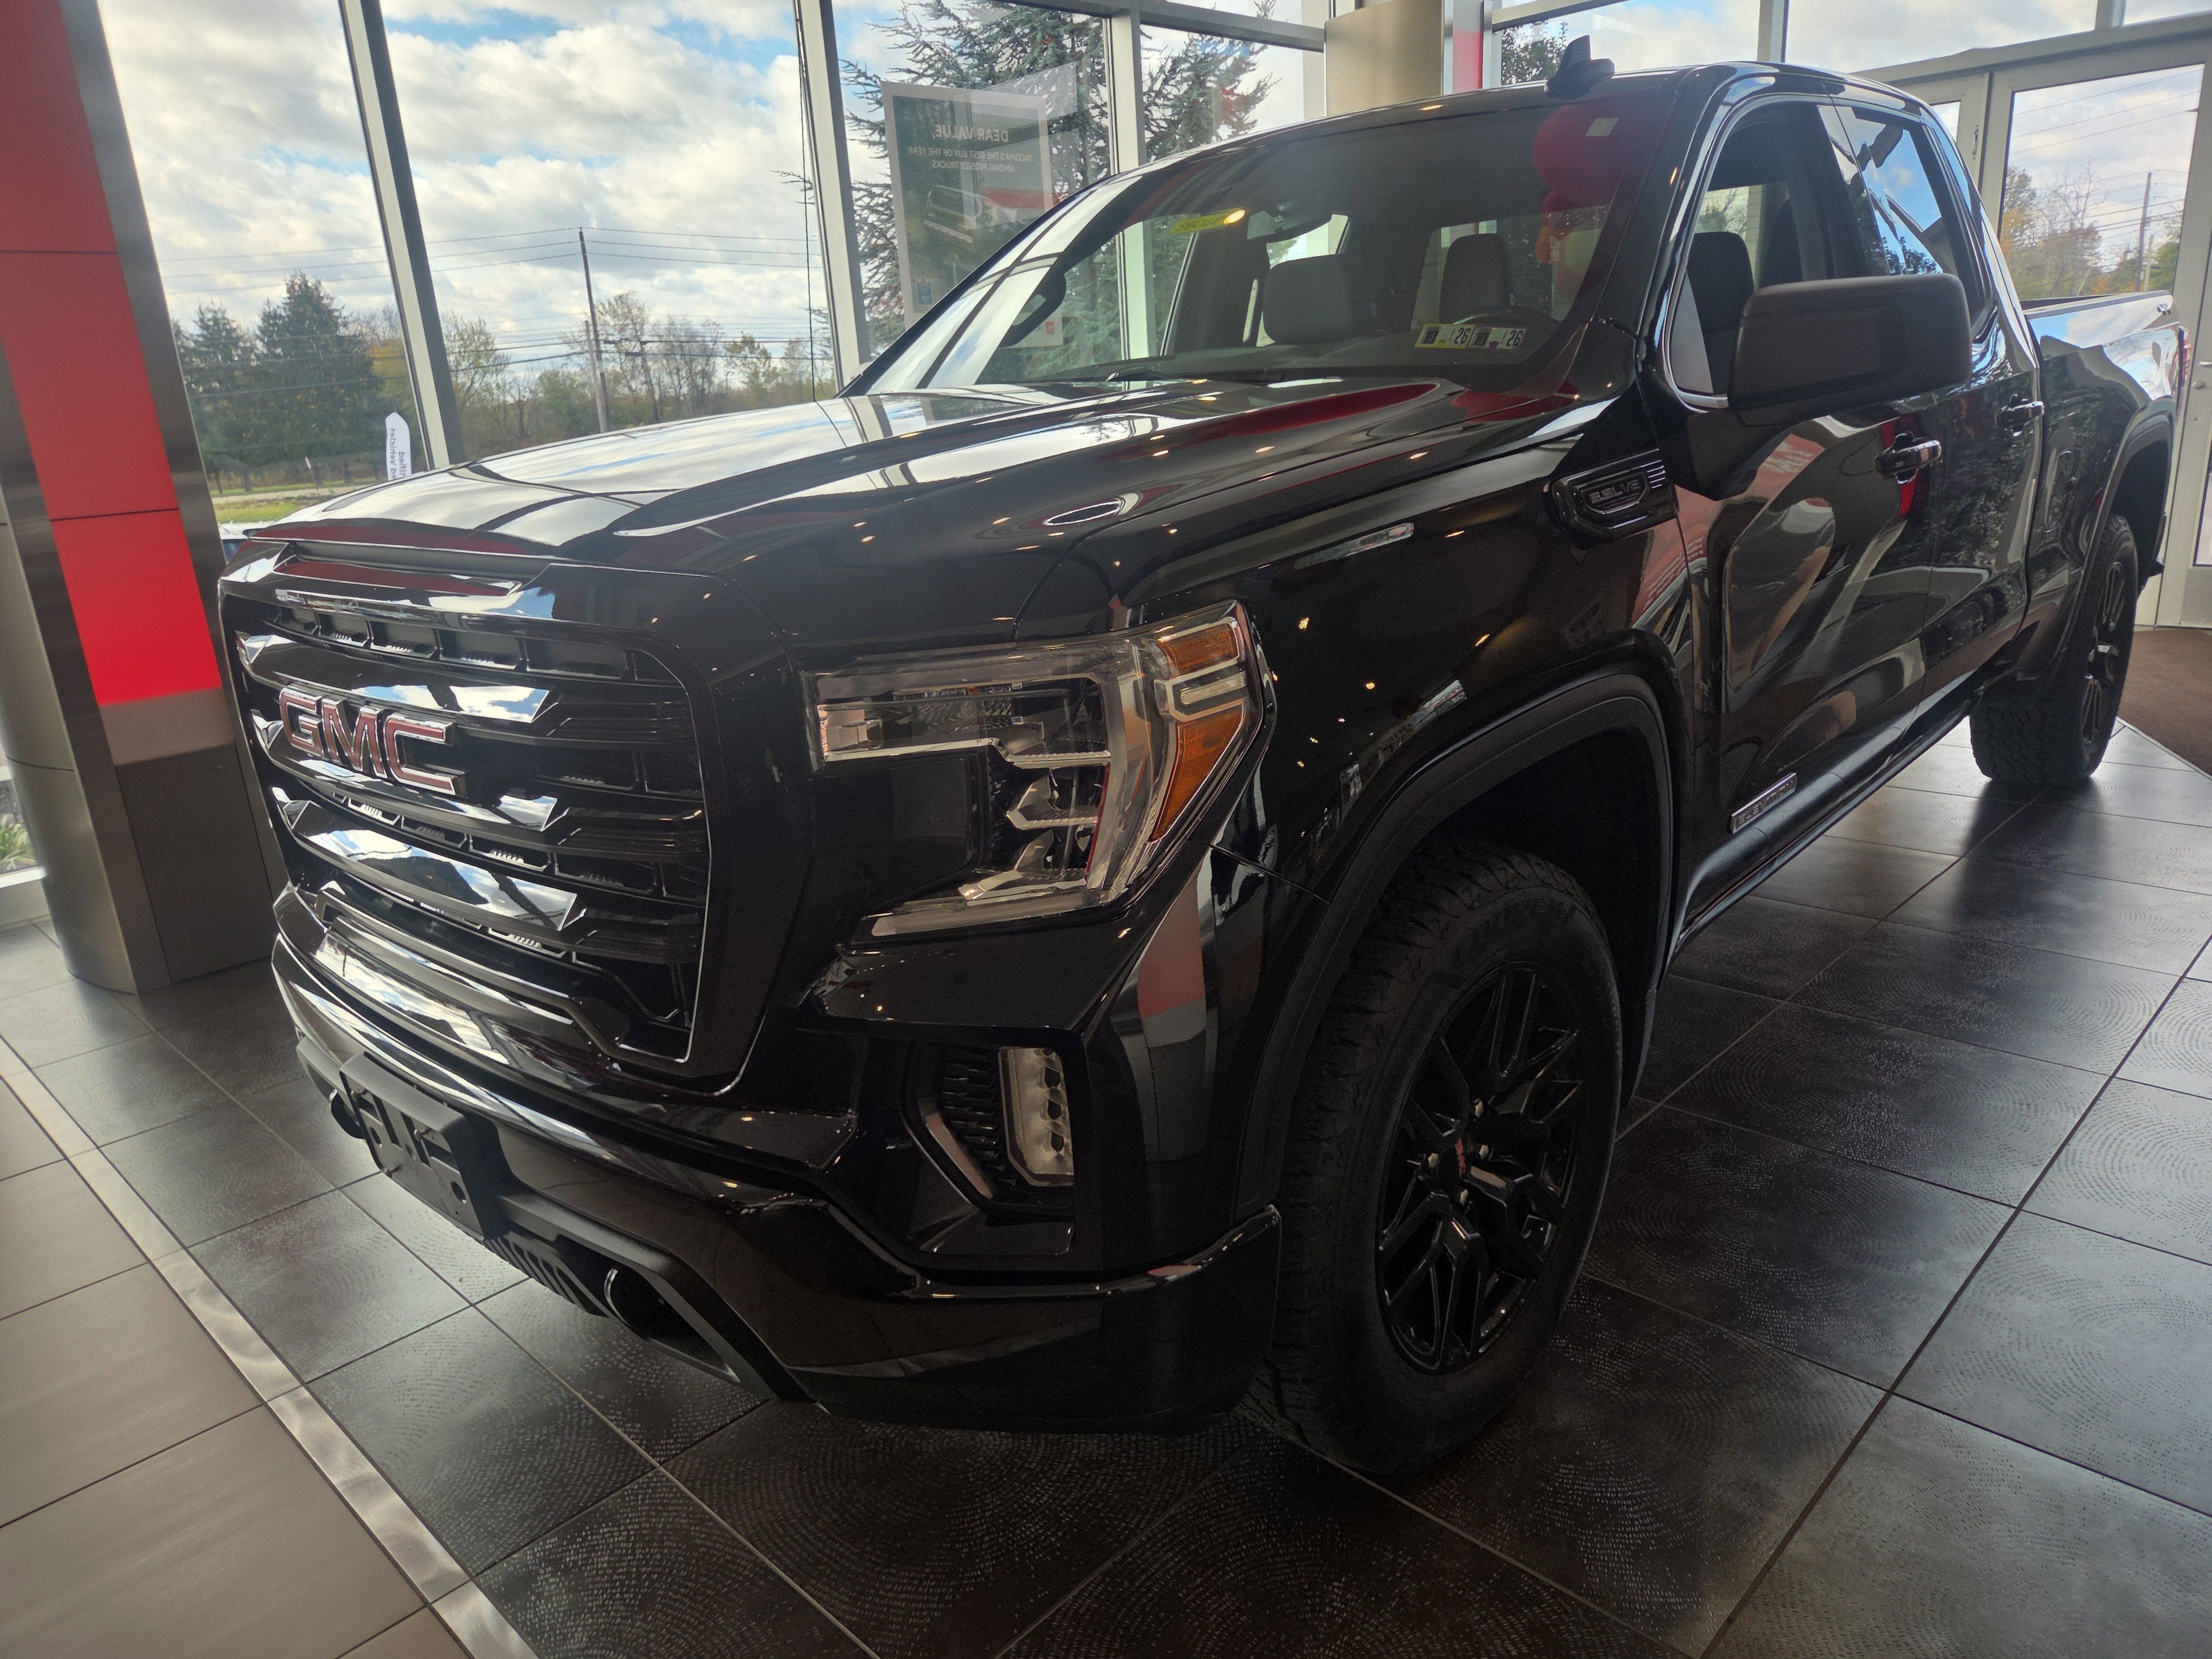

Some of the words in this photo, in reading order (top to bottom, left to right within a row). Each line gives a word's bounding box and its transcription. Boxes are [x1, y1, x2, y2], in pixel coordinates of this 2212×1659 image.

[1423, 330, 1439, 344] 10
[1454, 327, 1471, 344] 26
[1475, 332, 1490, 346] 10
[1506, 330, 1524, 348] 26
[279, 685, 460, 796] GMC
